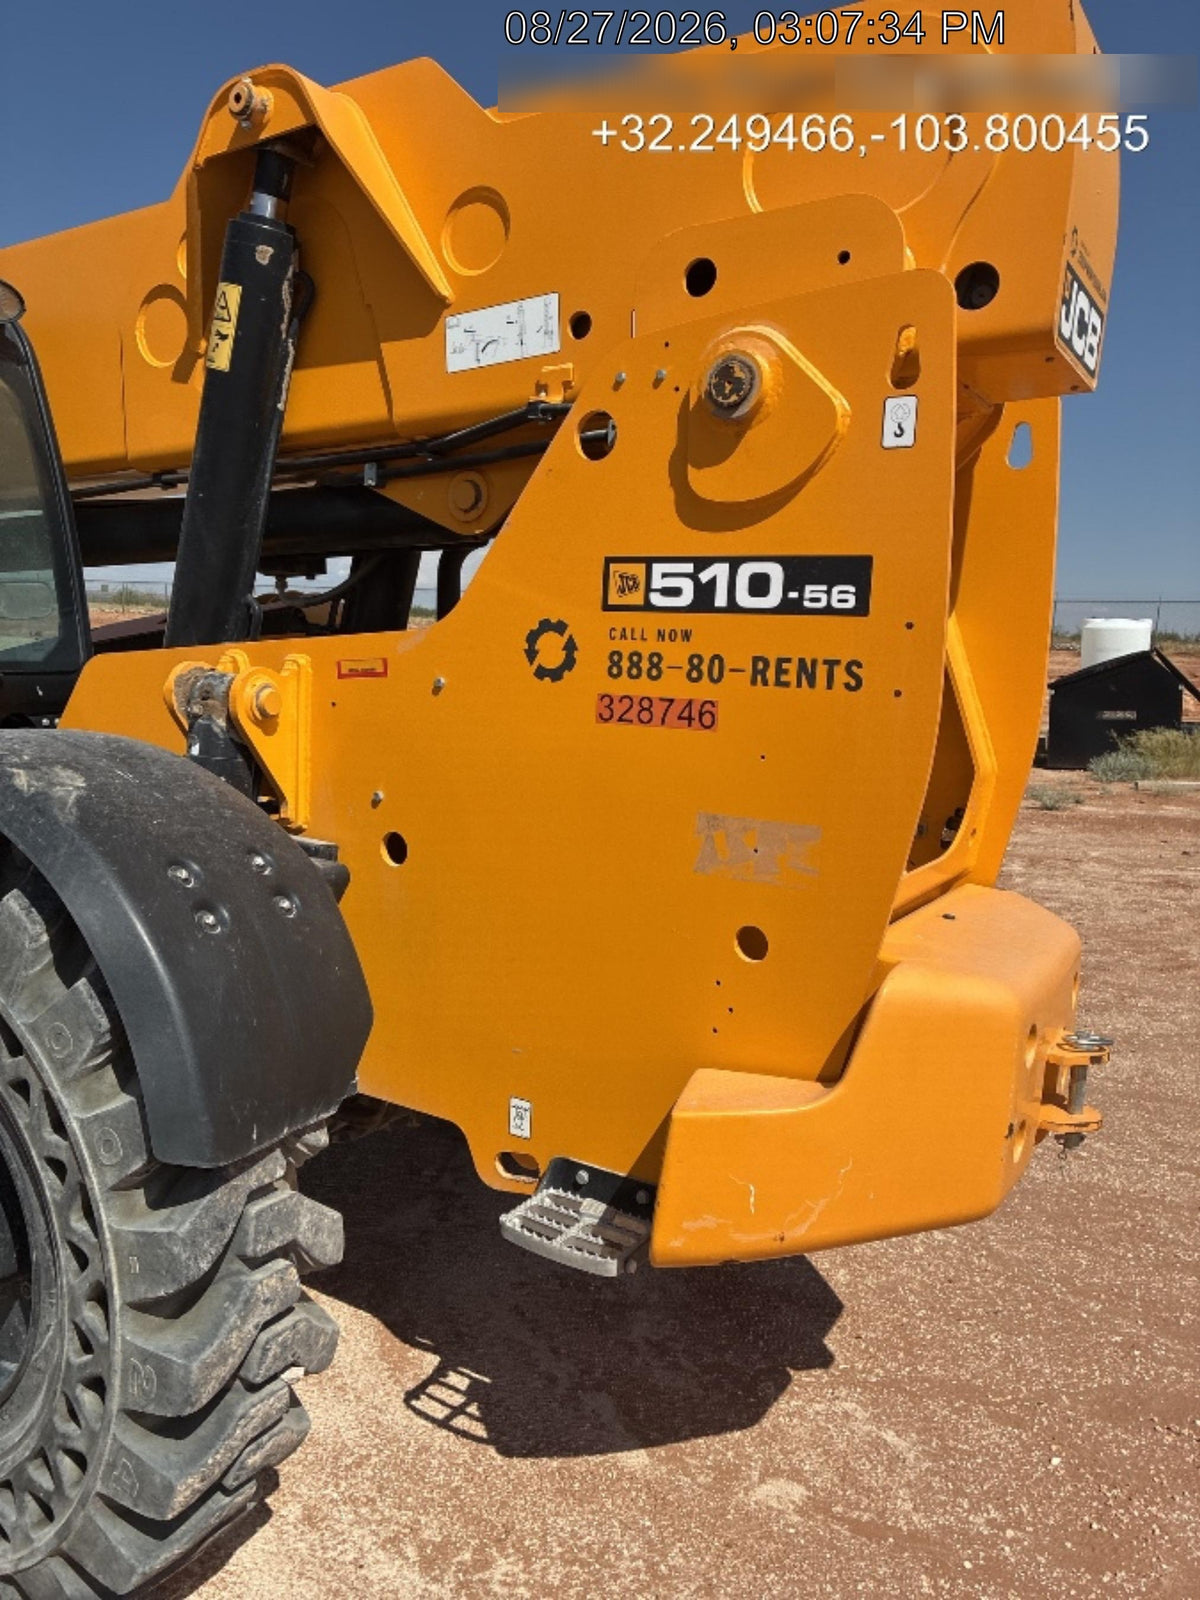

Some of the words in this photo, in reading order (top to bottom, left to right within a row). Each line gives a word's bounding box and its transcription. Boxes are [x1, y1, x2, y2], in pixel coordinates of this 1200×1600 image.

[1061, 280, 1102, 371] JCB
[608, 627, 647, 642] CALL
[657, 629, 693, 643] NOW
[607, 650, 864, 692] 888-80-RENTS
[598, 693, 716, 730] 328746
